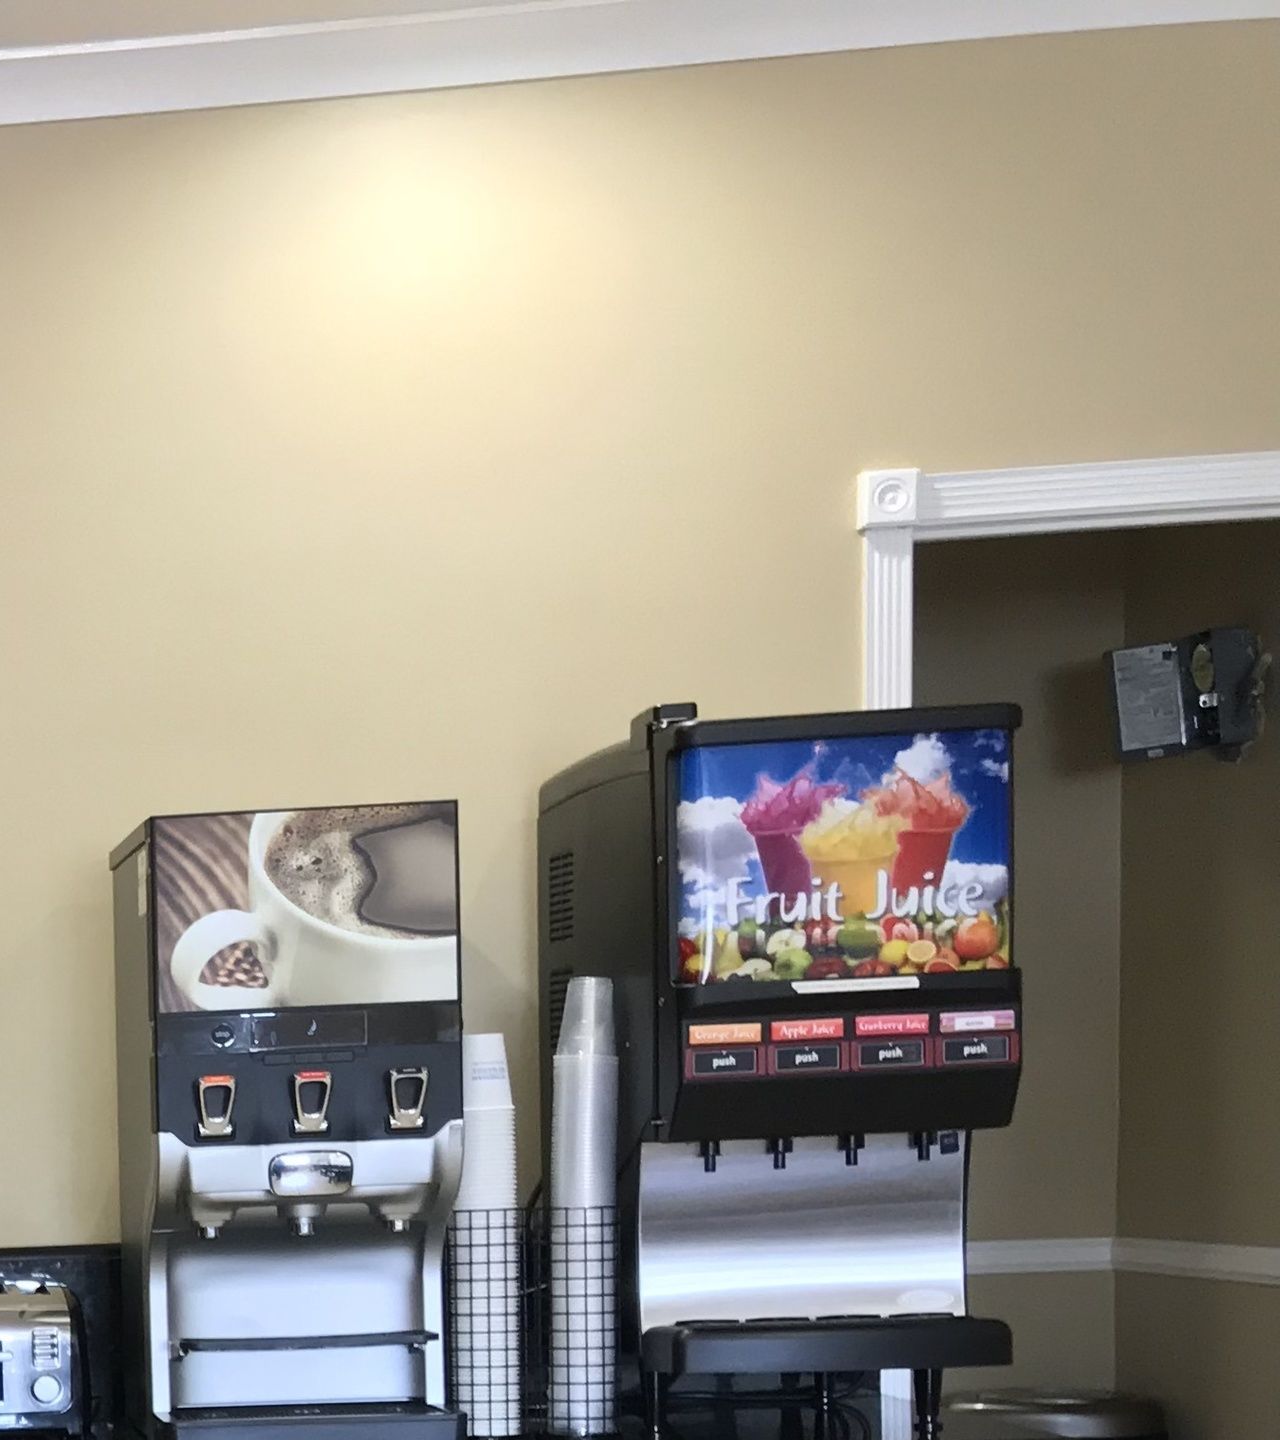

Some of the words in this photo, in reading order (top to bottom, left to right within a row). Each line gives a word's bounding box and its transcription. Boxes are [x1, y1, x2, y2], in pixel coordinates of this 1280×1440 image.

[726, 876, 845, 924] Fruit
[865, 868, 984, 918] Juice
[779, 1025, 807, 1039] Apple
[878, 1046, 904, 1062] push
[962, 1042, 989, 1058] push
[712, 1054, 737, 1070] push
[794, 1051, 820, 1066] push
